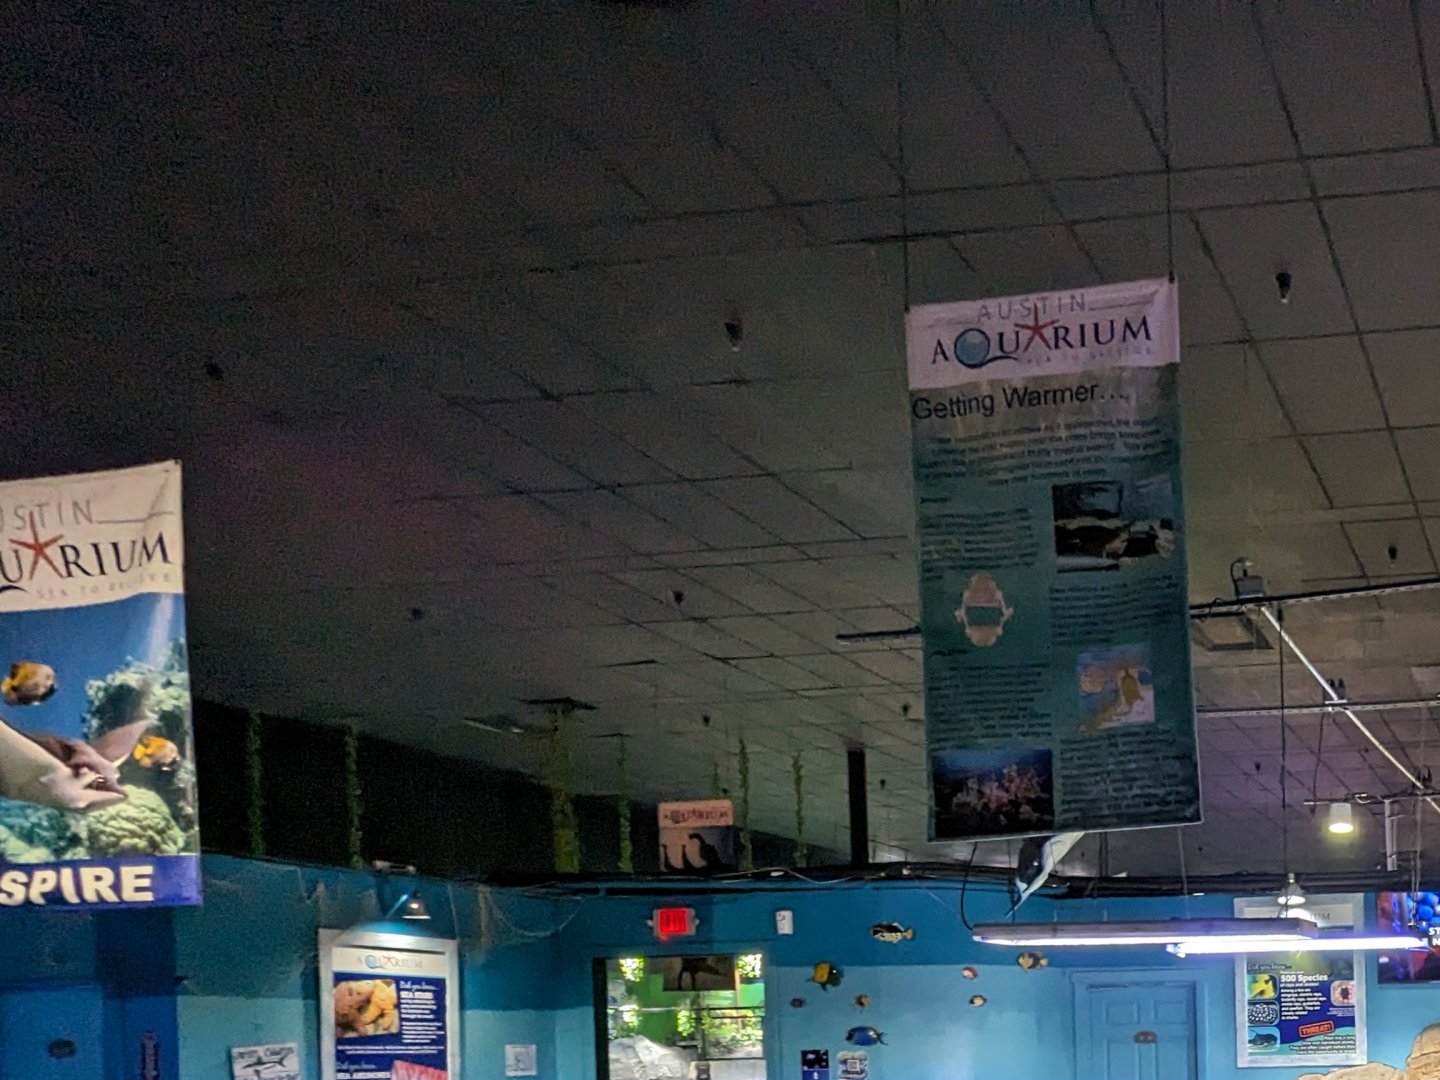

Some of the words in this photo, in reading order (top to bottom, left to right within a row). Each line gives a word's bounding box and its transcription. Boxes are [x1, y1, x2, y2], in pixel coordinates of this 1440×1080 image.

[976, 292, 1087, 323] AUSTIN
[931, 314, 1152, 368] AQUARIUM
[912, 391, 995, 420] Getting
[0, 499, 95, 531] STIN
[0, 528, 173, 586] UARIUM
[1280, 974, 1296, 982] 500
[1298, 973, 1328, 983] Species
